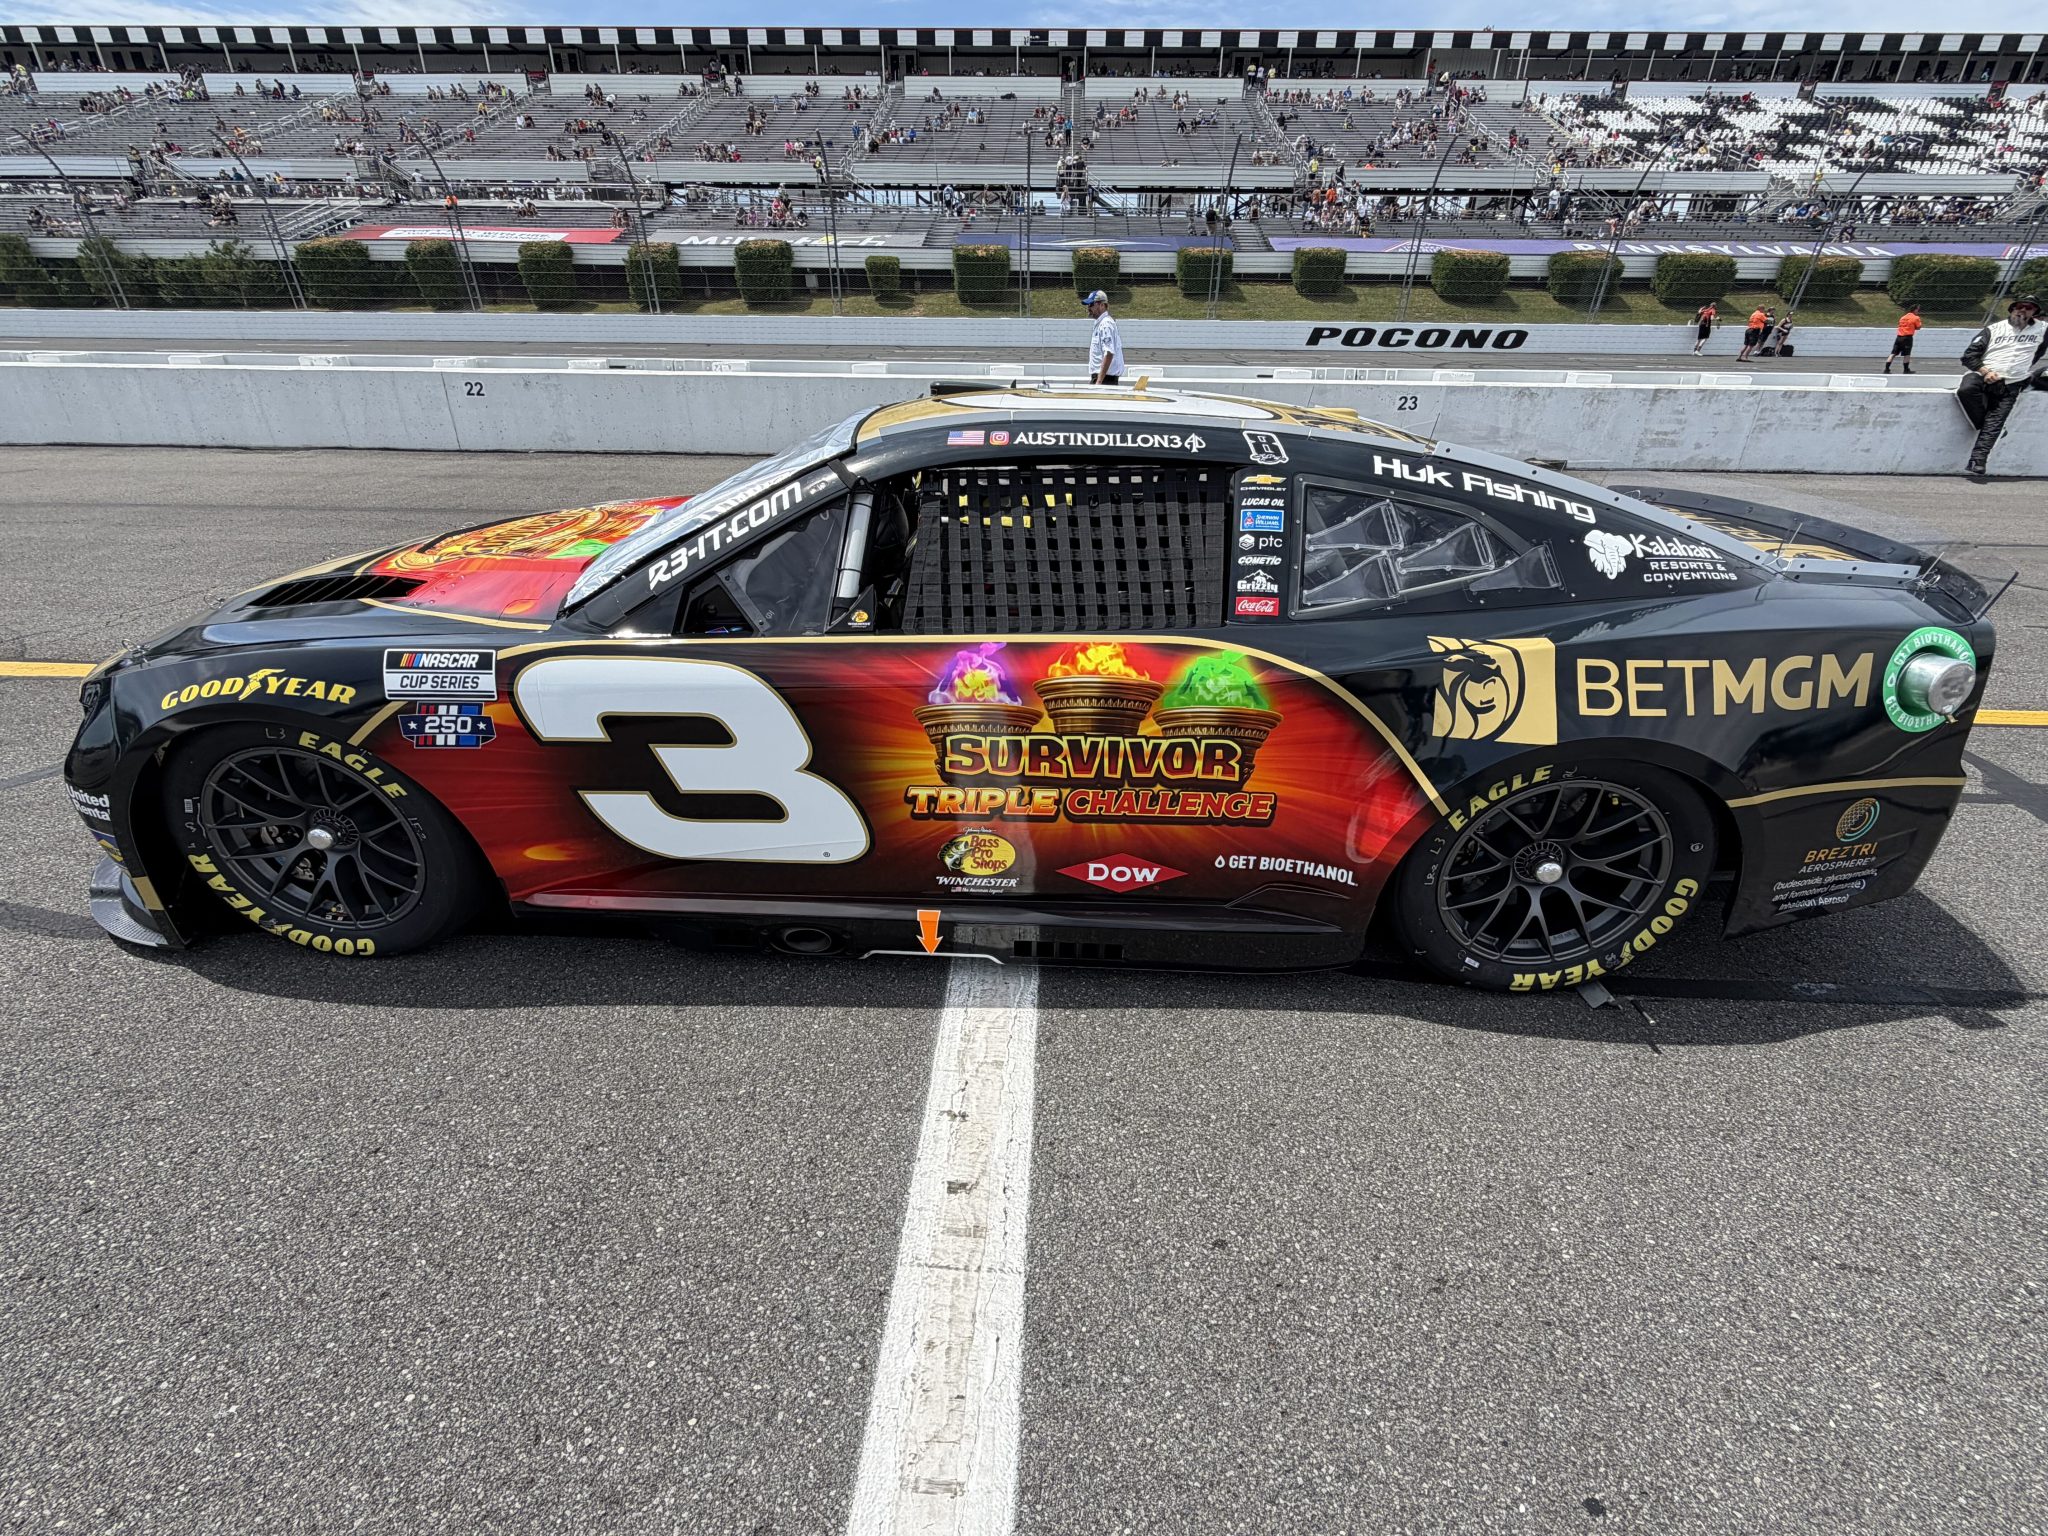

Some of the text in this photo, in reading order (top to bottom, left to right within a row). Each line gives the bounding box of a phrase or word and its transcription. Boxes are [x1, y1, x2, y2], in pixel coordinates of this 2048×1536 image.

[1305, 327, 1529, 349] POCONO
[1994, 334, 2038, 344] OFFICIAL
[464, 381, 485, 396] 22
[1397, 396, 1418, 411] 23
[1013, 432, 1182, 448] AUSTINDILLON3
[1372, 455, 1597, 524] Huk Fishing
[1241, 498, 1285, 507] LUCAS OIL
[1259, 534, 1283, 550] ptc
[1238, 555, 1282, 566] COMETIC
[1651, 561, 1727, 571] RESORTS &
[1643, 571, 1738, 582] CONVENTIONS
[1237, 579, 1279, 593] Grizzly
[419, 653, 480, 668] NASCAR
[1894, 645, 1912, 666] GET
[400, 675, 480, 689] CUP SERIES
[1577, 652, 1874, 717] BETMGM
[1886, 696, 1899, 716] GET
[424, 716, 472, 733] 250
[299, 731, 408, 799] EAGLE
[514, 656, 871, 865] 3
[944, 734, 1243, 782] SURVIVOR
[65, 783, 110, 808] United
[907, 785, 1275, 819] TRIPLE CHALLENGE
[1448, 764, 1554, 832] EAGLE
[74, 799, 111, 822] Renta
[970, 835, 1000, 848] Bass
[972, 846, 993, 858] Pro
[1804, 842, 1878, 863] BREZTRI
[971, 857, 1008, 872] Shops
[1229, 855, 1257, 870] GET
[936, 876, 1017, 888] WINCHESTER
